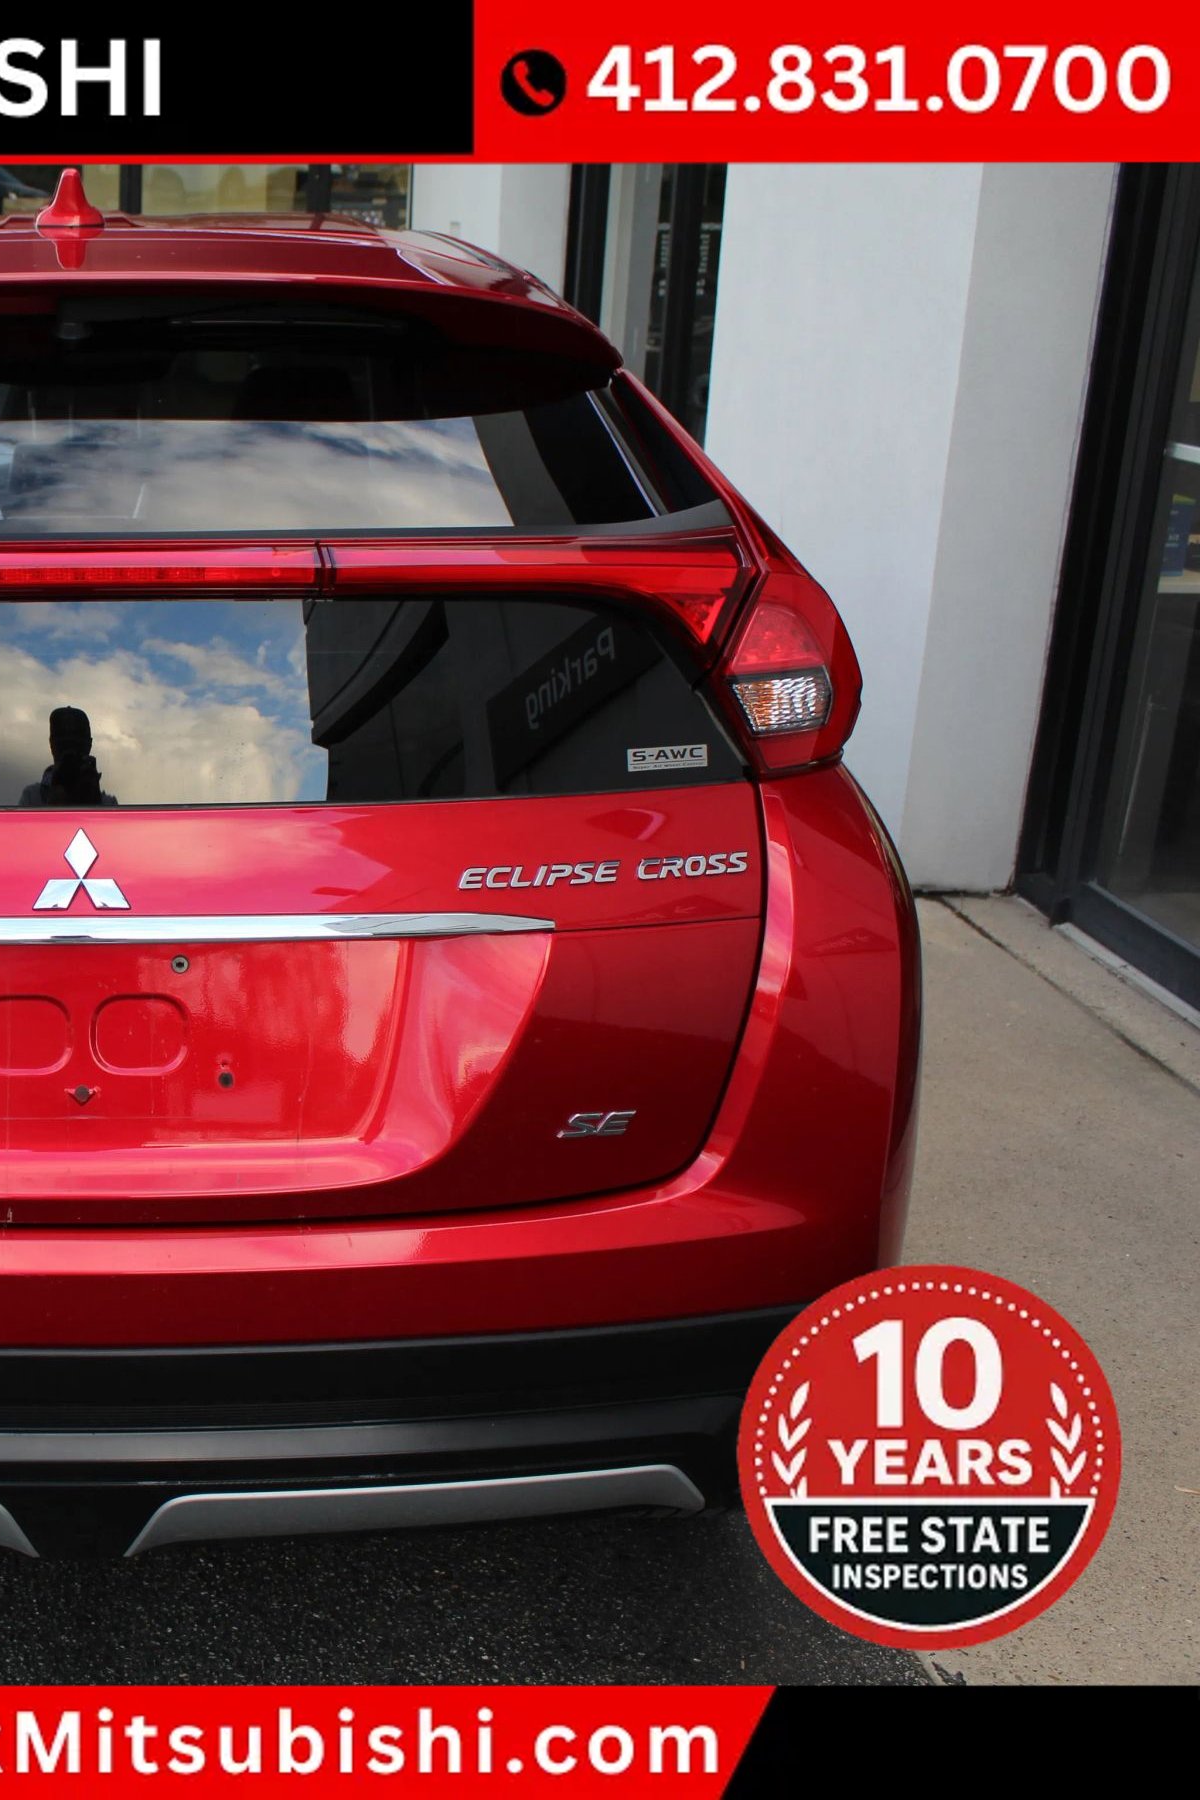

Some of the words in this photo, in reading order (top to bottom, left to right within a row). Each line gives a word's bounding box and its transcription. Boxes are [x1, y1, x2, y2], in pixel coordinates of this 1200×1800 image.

[631, 746, 704, 763] S-AWC
[457, 860, 620, 890] ECLIPSE
[637, 851, 748, 880] CROSS
[556, 1110, 637, 1139] SE
